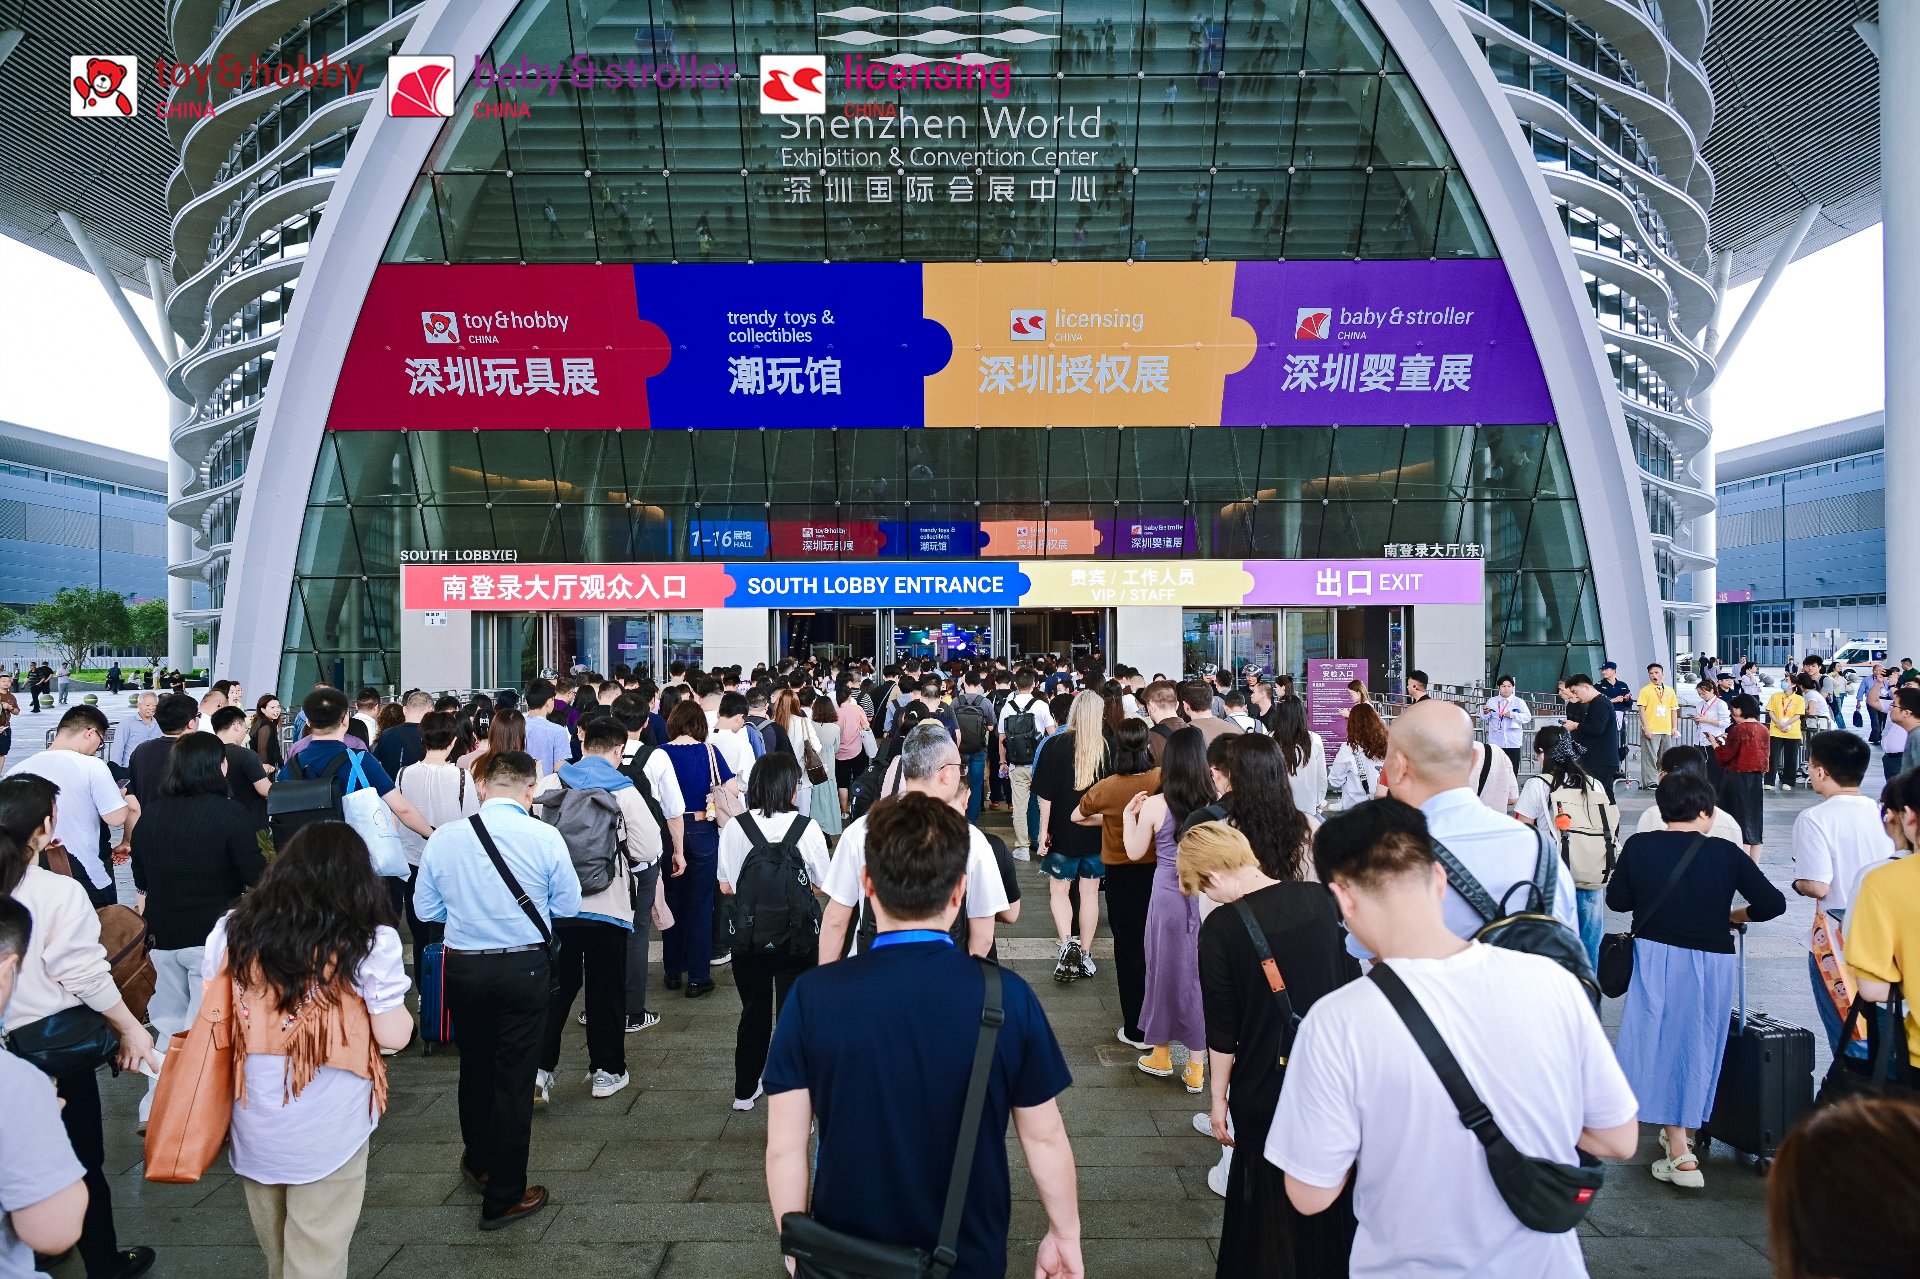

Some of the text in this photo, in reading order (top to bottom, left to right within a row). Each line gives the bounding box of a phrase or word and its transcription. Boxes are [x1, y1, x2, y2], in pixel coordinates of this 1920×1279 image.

[780, 106, 1101, 139] Shenzhen World
[781, 147, 1099, 167] Exhibition & Convention Center
[783, 176, 1098, 203] 深圳国际会展中心
[727, 309, 836, 328] trendy toys &
[1054, 308, 1145, 332] licensing
[468, 335, 500, 344] CHINA
[728, 327, 813, 343] collectibles
[1054, 332, 1083, 342] CHINA
[1337, 331, 1367, 340] CHINA
[404, 356, 600, 397] 深圳玩具展
[727, 355, 842, 395] 潮玩馆
[978, 353, 1170, 395] 深圳授权展
[1280, 352, 1474, 393] 深圳婴童展
[400, 550, 518, 562] SOUTH LOBBY(E)
[1383, 543, 1485, 558] 南登录大厅(东)
[441, 573, 687, 602] 南登录大厅观众入口
[747, 576, 1004, 595] SOUTH LOBBY ENTRANCE
[1316, 567, 1424, 598] 出口 EXIT
[1091, 589, 1116, 601] VIP
[1130, 589, 1176, 601] STAFF
